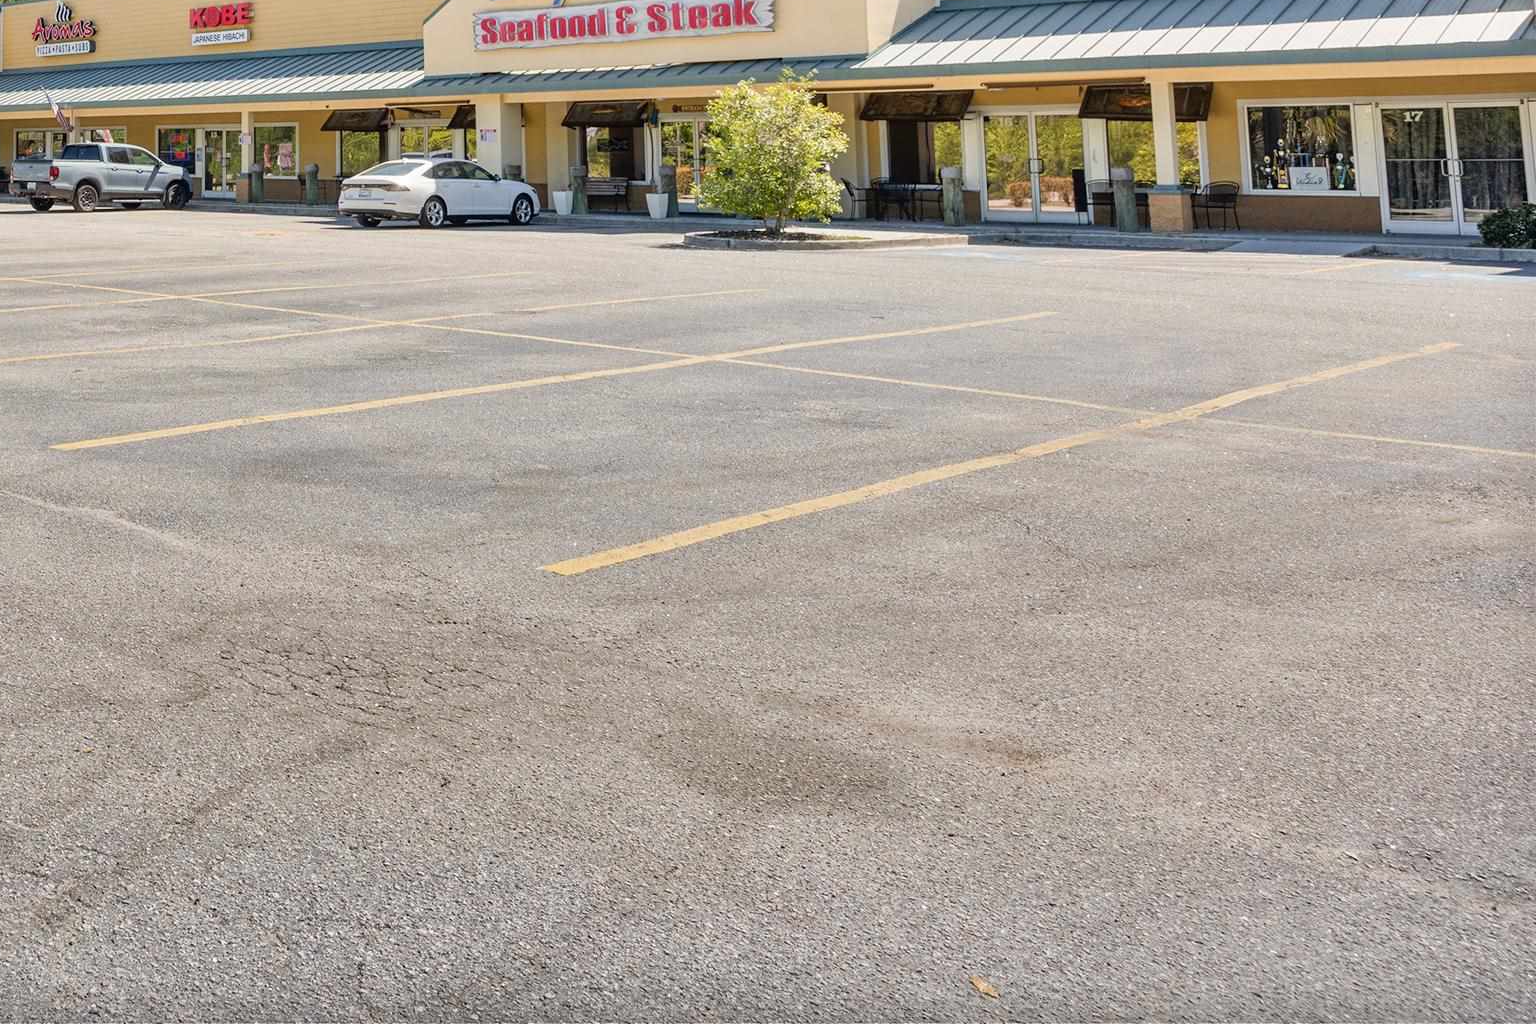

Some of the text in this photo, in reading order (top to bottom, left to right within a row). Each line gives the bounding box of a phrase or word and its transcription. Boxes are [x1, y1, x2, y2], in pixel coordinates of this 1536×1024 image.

[190, 2, 253, 29] KOBE
[479, 10, 609, 45] Seafood
[31, 17, 96, 44] Aromas
[192, 33, 222, 44] JAPANESE
[1402, 111, 1423, 122] 17
